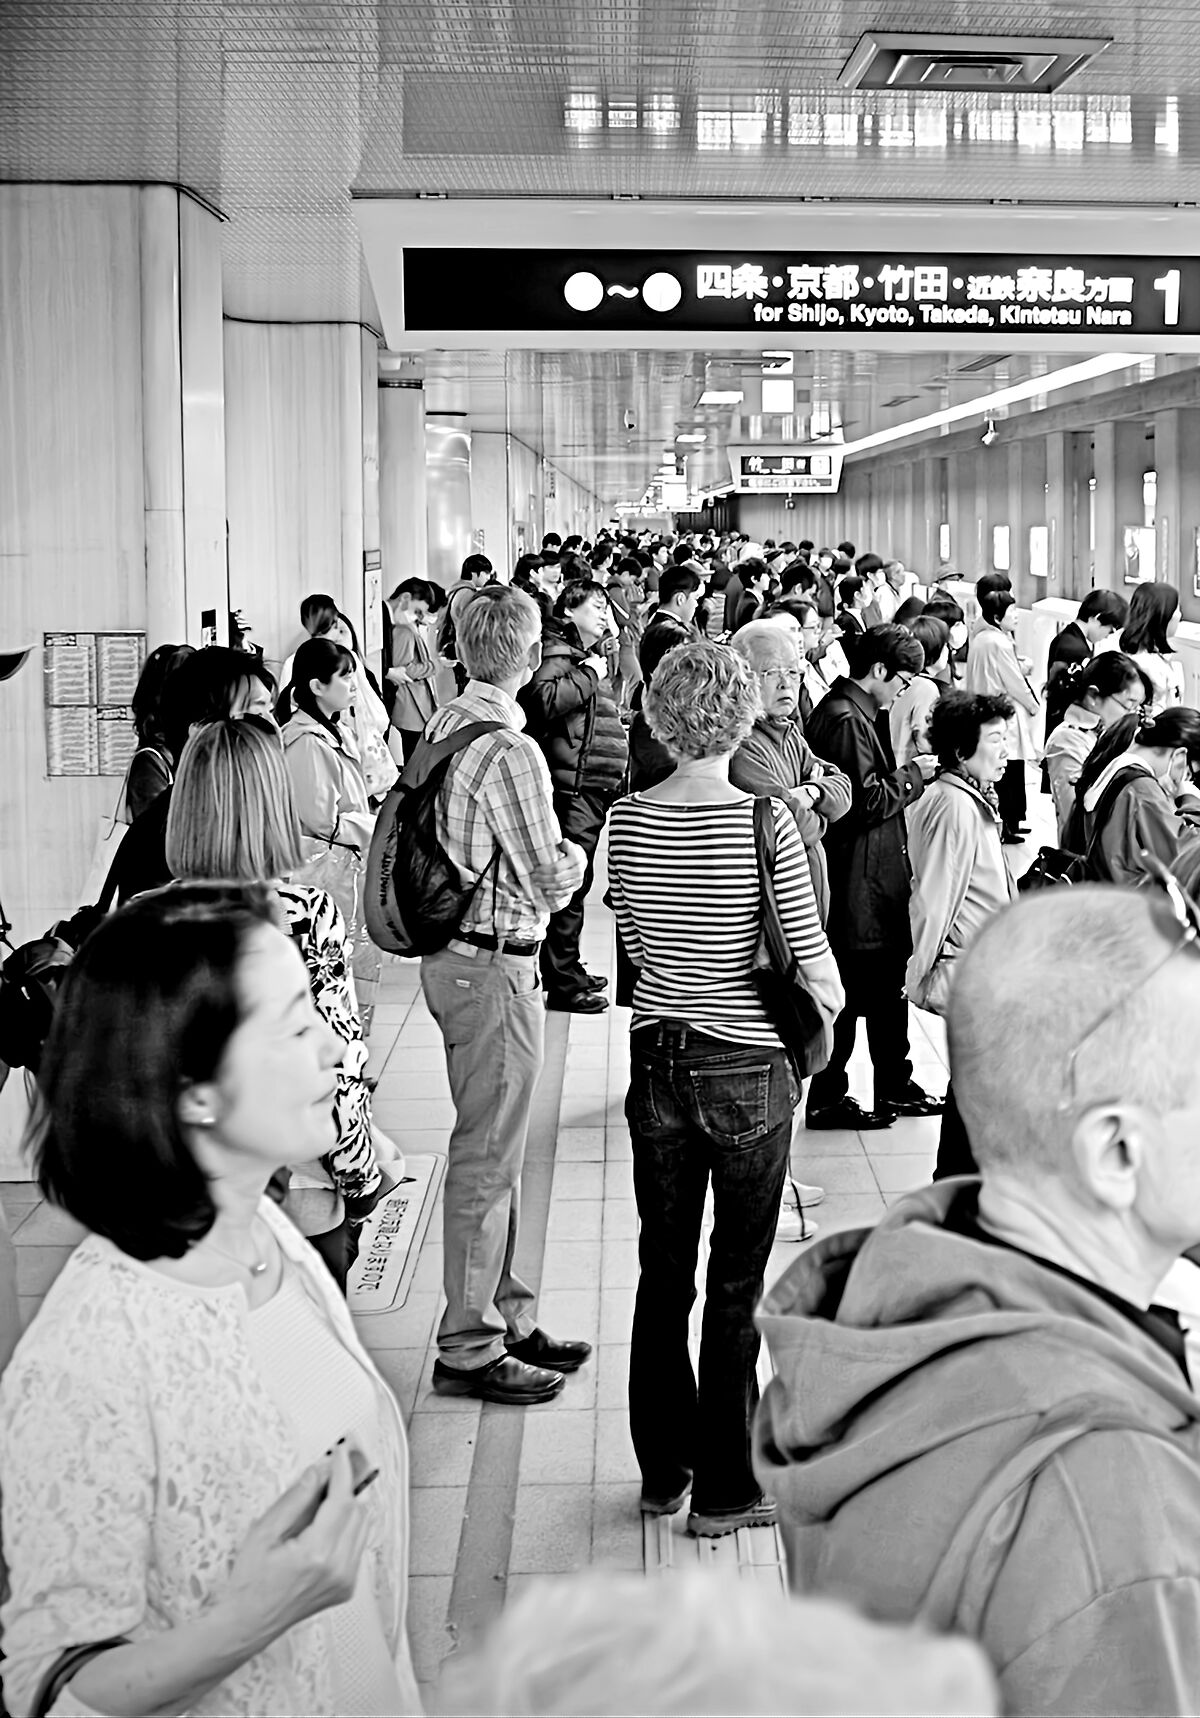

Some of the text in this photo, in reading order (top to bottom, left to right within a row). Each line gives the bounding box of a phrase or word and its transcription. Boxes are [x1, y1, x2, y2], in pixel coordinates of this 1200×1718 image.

[753, 302, 1133, 327] for Shijo, Kyoto, Takeda, Kintetsu Nara
[1154, 269, 1181, 325] 1
